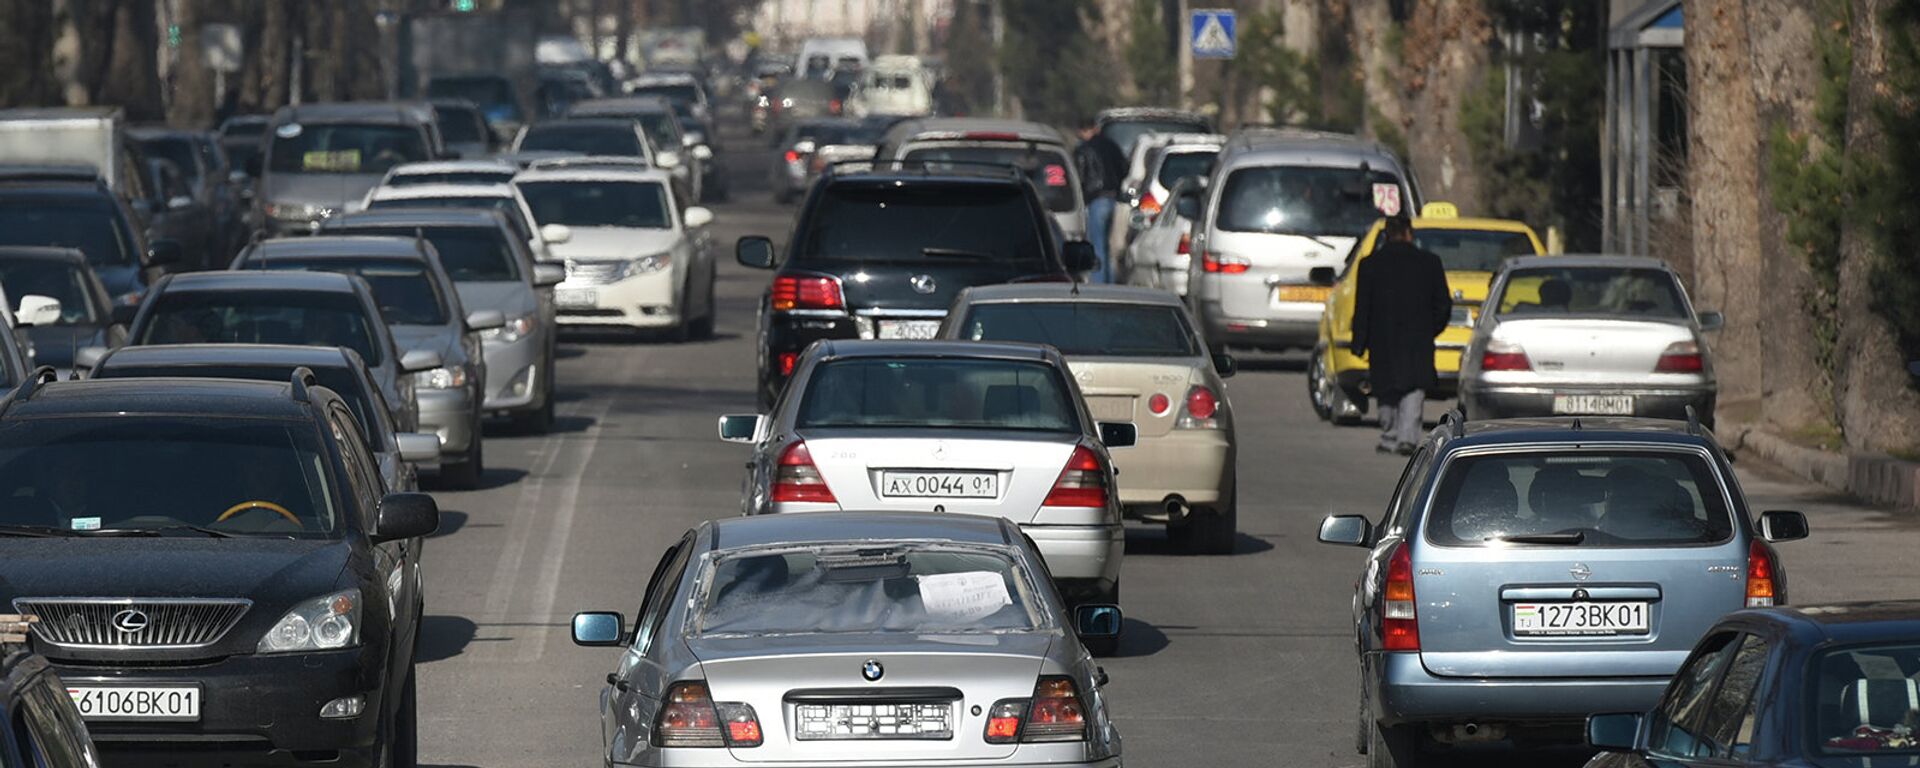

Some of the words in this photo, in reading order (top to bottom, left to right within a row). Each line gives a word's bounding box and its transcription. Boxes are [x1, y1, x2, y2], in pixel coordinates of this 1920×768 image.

[1043, 164, 1067, 187] 2
[1377, 186, 1400, 214] 25
[916, 476, 963, 494] 0044
[972, 477, 990, 489] 01
[1520, 618, 1532, 628] TJ
[1537, 605, 1641, 627] 1273BK01
[80, 691, 192, 714] 6106BK01
